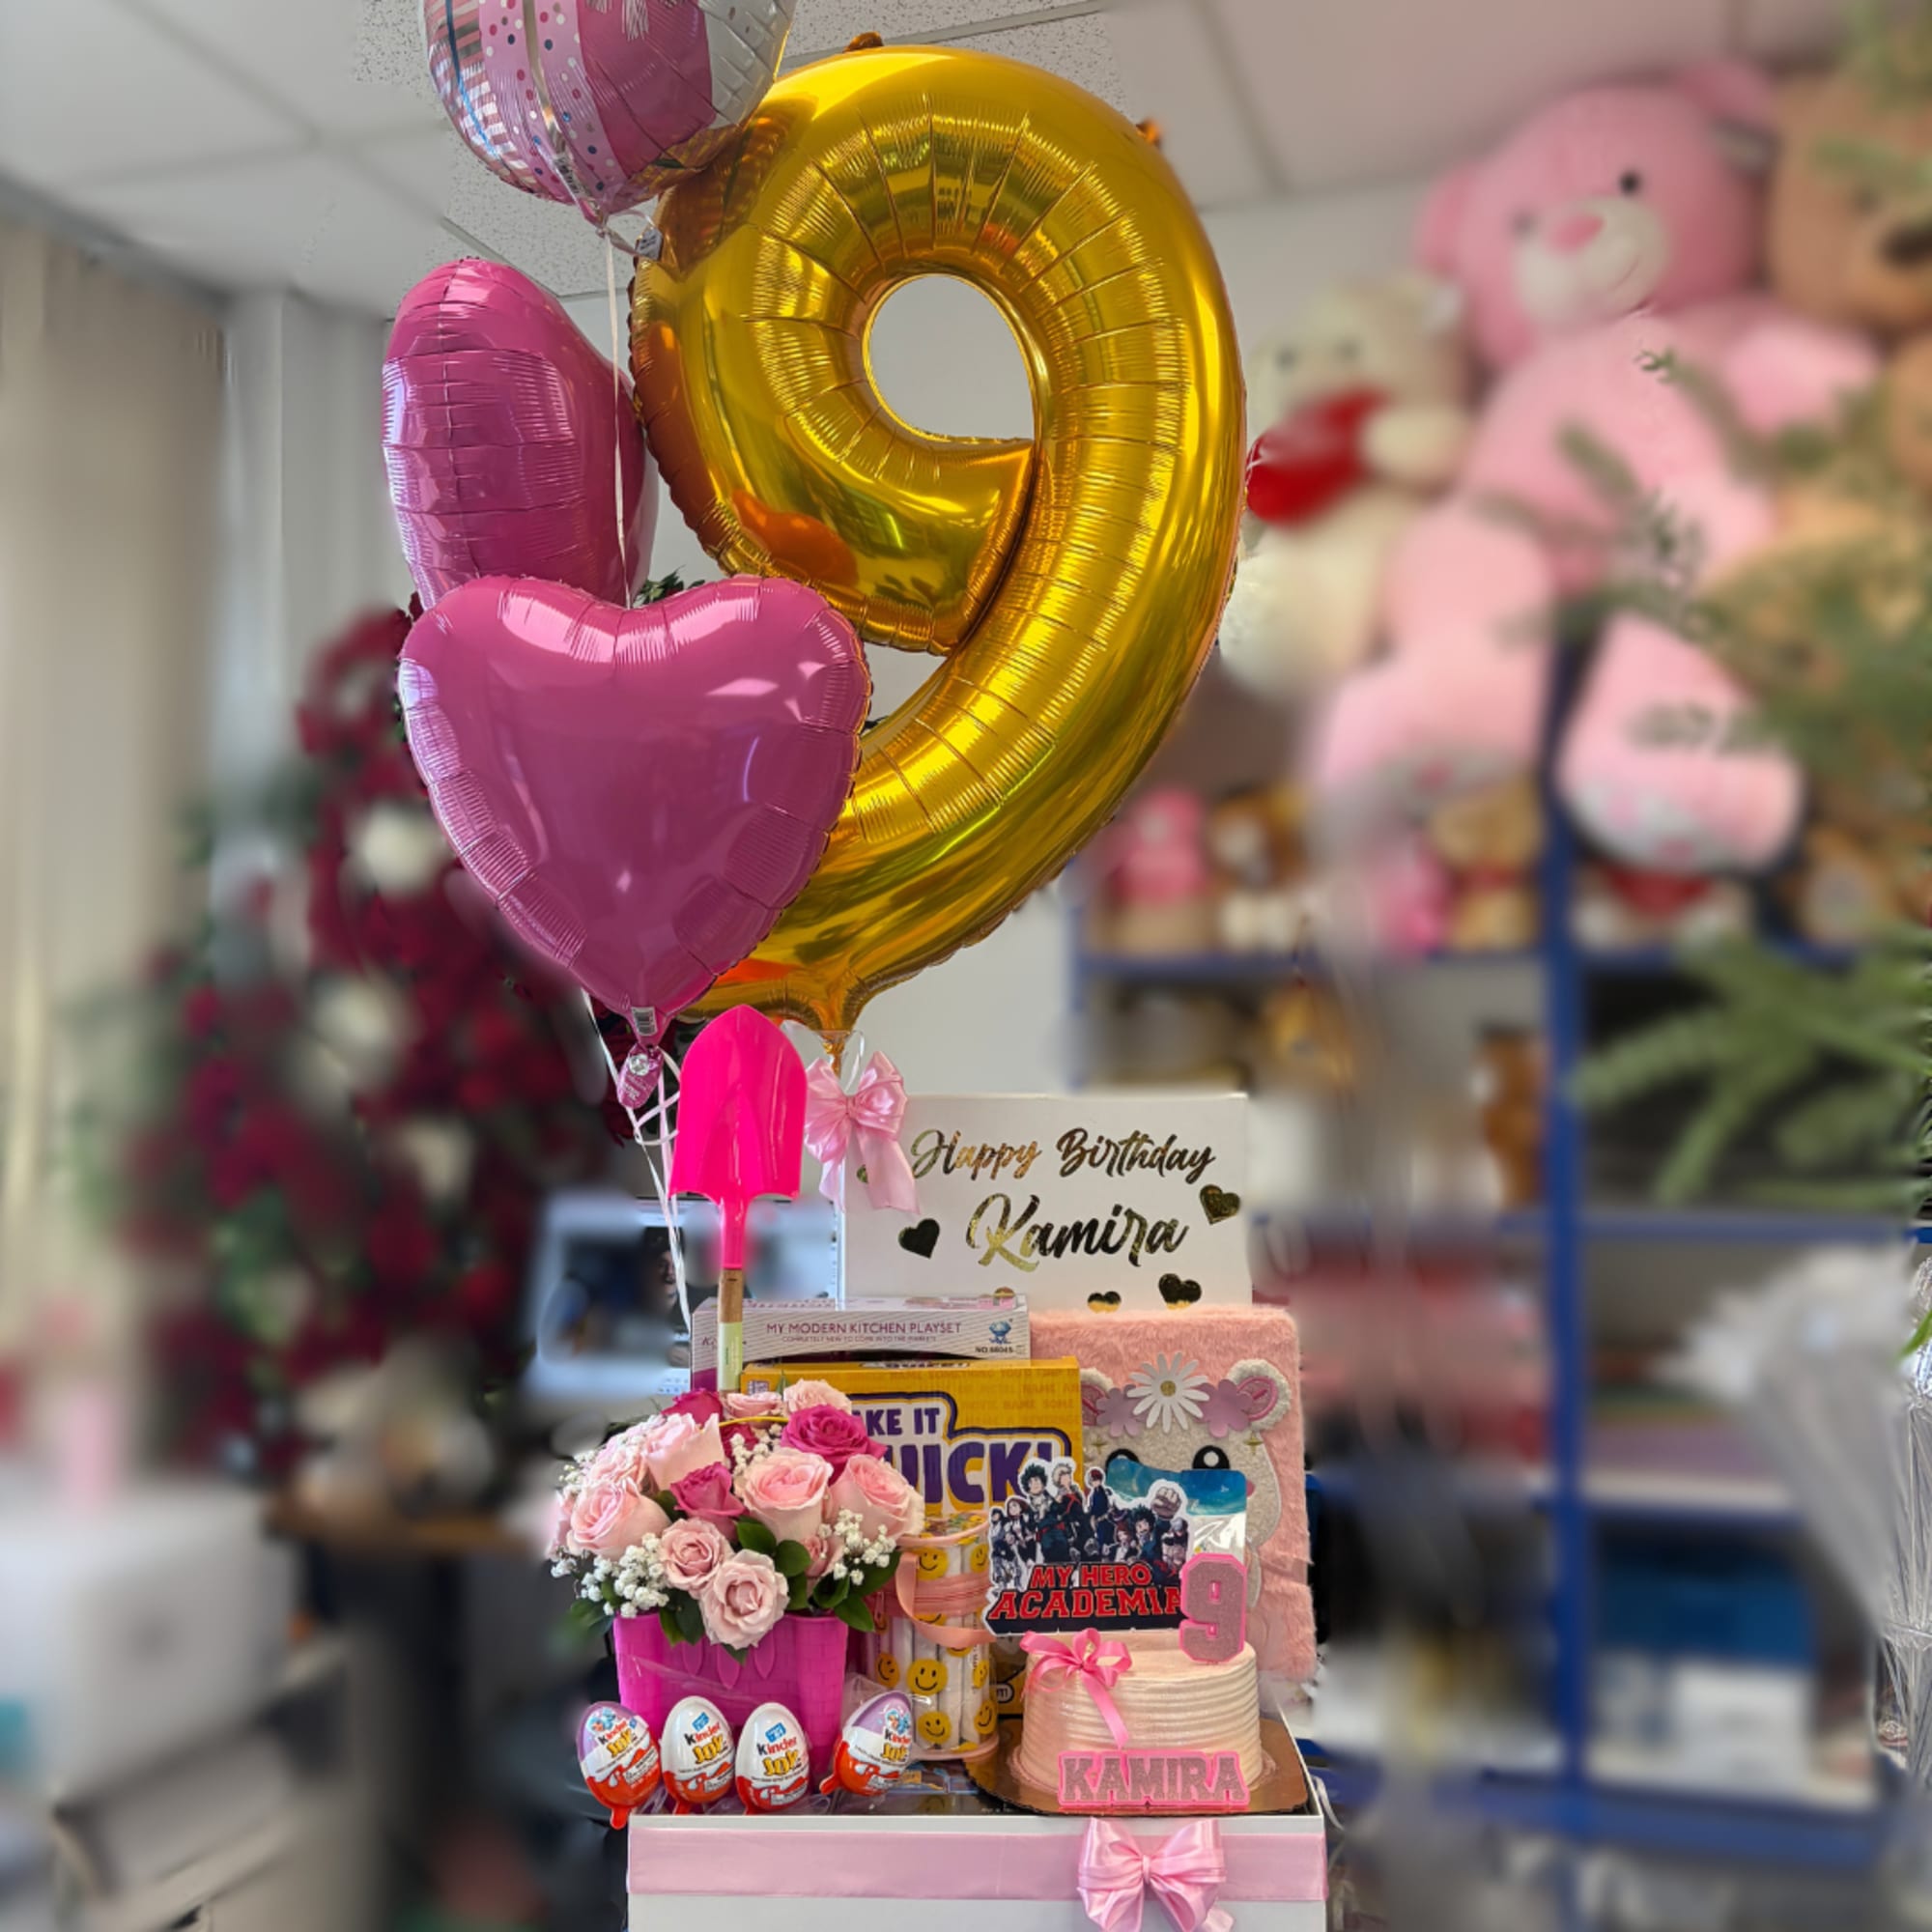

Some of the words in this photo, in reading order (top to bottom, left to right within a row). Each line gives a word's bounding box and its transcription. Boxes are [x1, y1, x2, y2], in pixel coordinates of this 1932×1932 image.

[910, 1129, 1042, 1180] Happy
[1056, 1127, 1216, 1184] Birthday
[965, 1192, 1189, 1273] Kamira
[766, 1322, 784, 1333] MY
[788, 1322, 847, 1333] MODERN
[850, 1322, 906, 1333] KITCHEN
[909, 1322, 962, 1333] PLAYSET
[851, 1407, 902, 1436] KE
[914, 1406, 940, 1435] IT
[1031, 1564, 1074, 1589] MY
[1081, 1563, 1151, 1587] HERO
[1179, 1552, 1247, 1663] 9
[1058, 1751, 1250, 1806] KAMIRA
